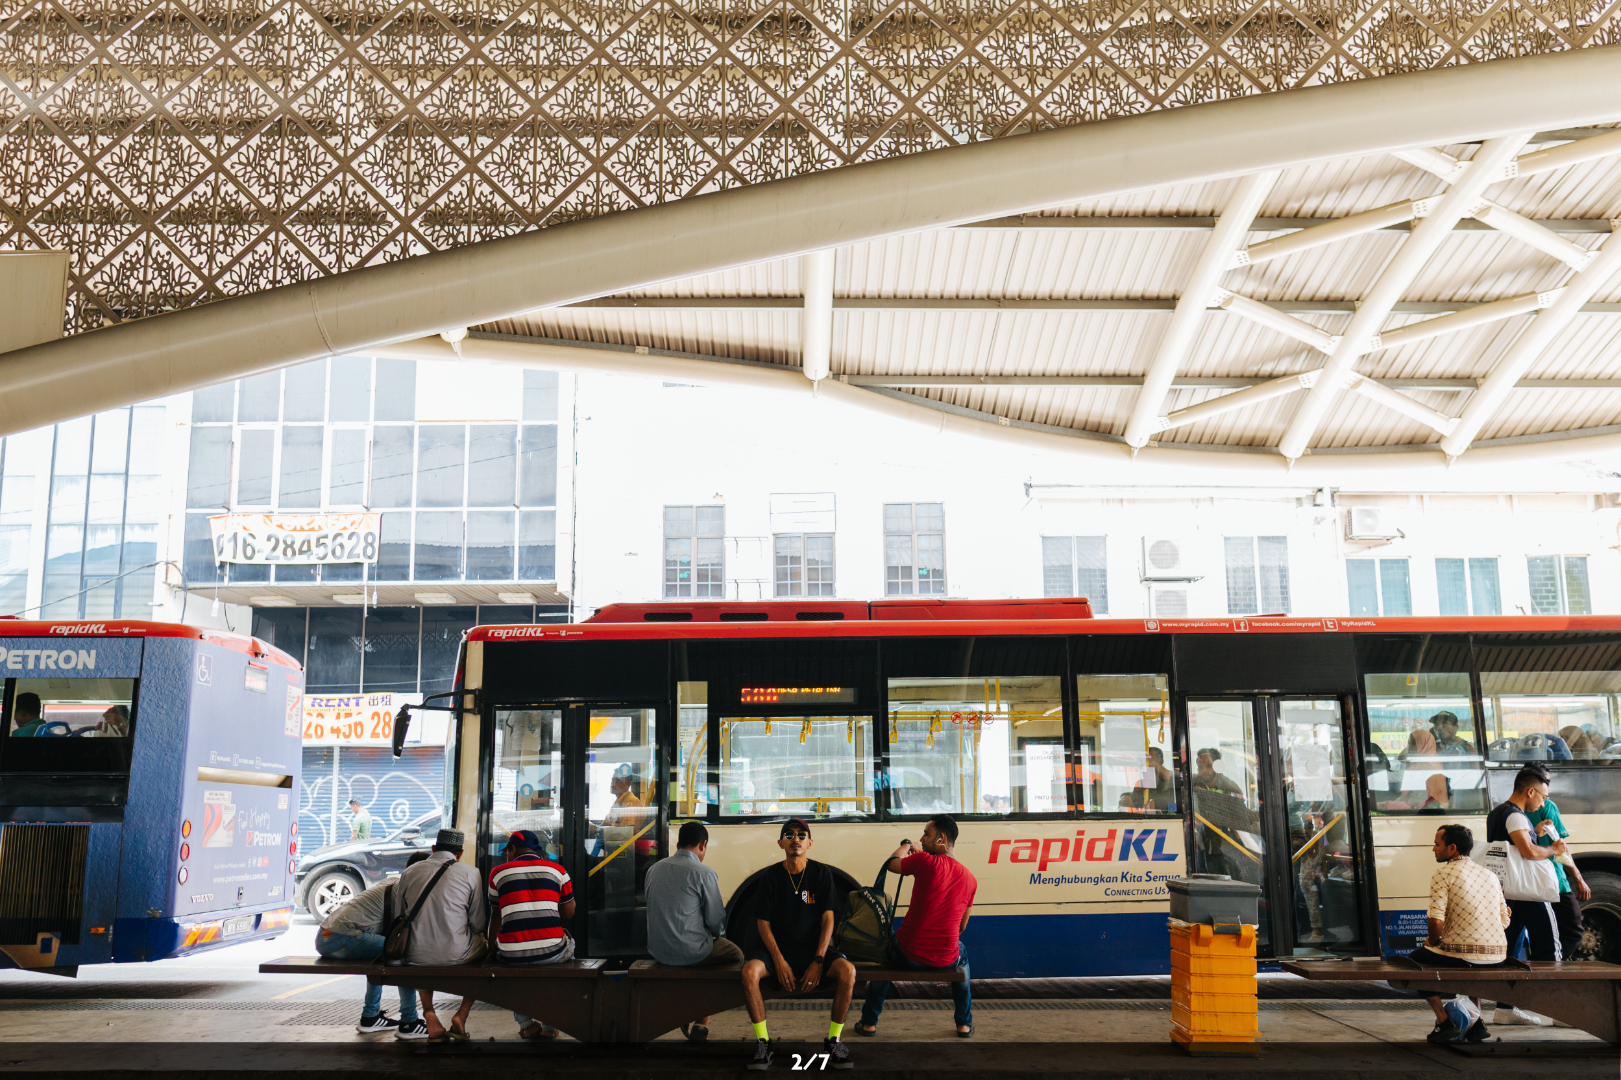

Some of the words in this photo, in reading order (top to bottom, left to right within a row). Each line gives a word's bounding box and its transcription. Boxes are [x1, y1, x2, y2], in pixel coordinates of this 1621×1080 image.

[49, 624, 107, 636] rapidKL
[1161, 621, 1230, 629] www.myrapid.com.my
[1251, 621, 1322, 629] facebook.com/myrapid
[488, 627, 544, 639] rapidKL
[311, 696, 364, 707] RENT
[368, 694, 392, 707] 出租
[370, 711, 392, 739] 28
[1381, 733, 1408, 741] RESTO
[253, 831, 282, 847] PETRON
[988, 828, 1179, 872] rapidKL
[1029, 872, 1118, 887] Menghubungkan
[1120, 871, 1143, 884] Kita
[191, 893, 214, 904] VOLVO
